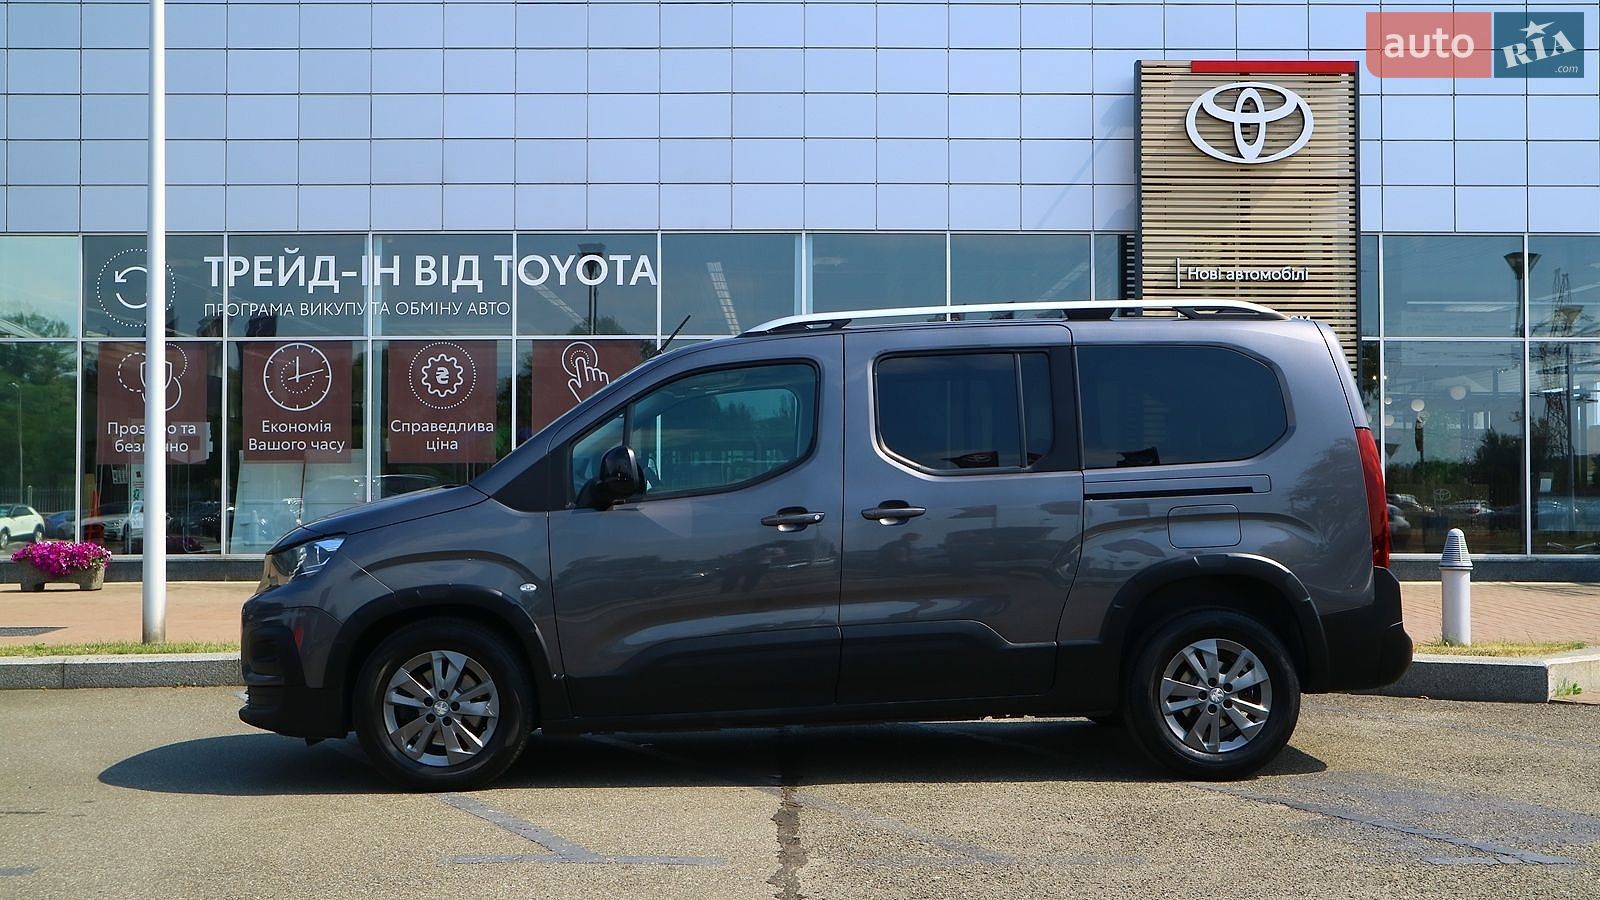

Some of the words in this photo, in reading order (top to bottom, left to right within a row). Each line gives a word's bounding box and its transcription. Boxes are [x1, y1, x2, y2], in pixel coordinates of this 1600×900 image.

[204, 248, 400, 294] ТРЕЙД-ІН
[415, 255, 483, 293] ВІД
[494, 254, 658, 286] TOYOTA
[1187, 267, 1222, 280] Нові
[1226, 266, 1309, 281] автомобілі
[204, 303, 295, 317] ПРОГРАМА
[301, 302, 368, 316] ВИКУПУ
[370, 301, 391, 316] ТА
[395, 301, 463, 316] ОБМІНУ
[467, 301, 511, 316] АВТО
[107, 422, 177, 438] Прозо
[181, 424, 196, 435] та
[262, 420, 332, 433] Економія
[390, 420, 495, 435] Справедлива
[115, 439, 189, 453] безно
[249, 439, 306, 451] Вашого
[311, 440, 346, 454] часу
[426, 437, 458, 452] ціна
